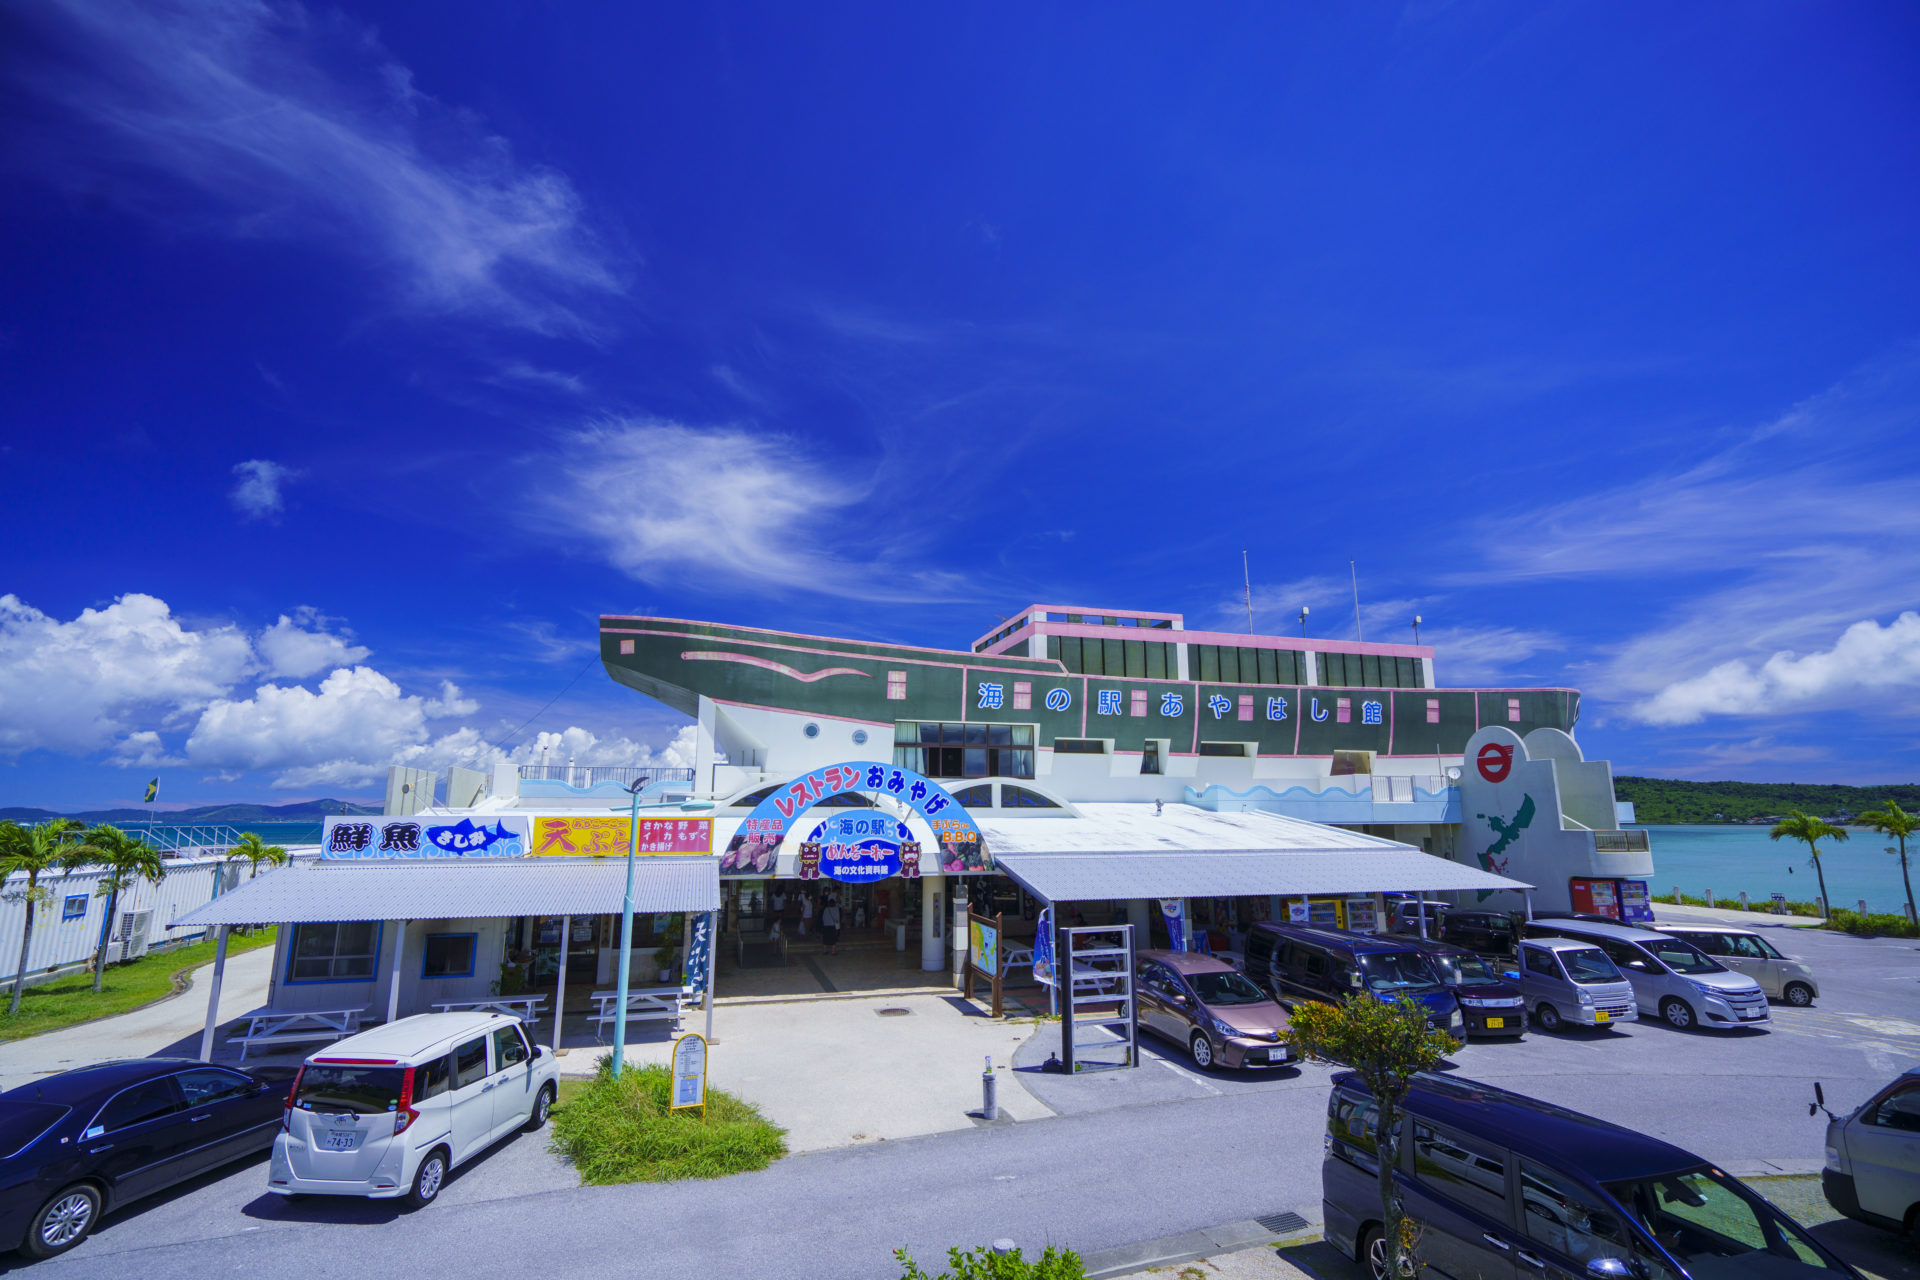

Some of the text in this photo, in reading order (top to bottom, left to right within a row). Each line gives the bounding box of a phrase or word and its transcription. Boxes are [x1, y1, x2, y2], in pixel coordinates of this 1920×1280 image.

[775, 765, 949, 818] レストラン おみやげ
[643, 821, 673, 830] さかな
[746, 818, 783, 831] 特産品
[839, 819, 886, 836] 海の駅
[329, 822, 420, 852] 鮮魚
[436, 830, 487, 848] さしみ
[534, 818, 630, 853] 天ぷら
[643, 831, 707, 840] イカ もずく
[747, 832, 776, 844] 販売
[943, 830, 976, 843] B.B.Q
[641, 842, 673, 852] かき揚げ
[826, 843, 894, 861] めんそーれー
[833, 864, 889, 876] 海の文化資料館
[332, 1137, 353, 1148] 74-33
